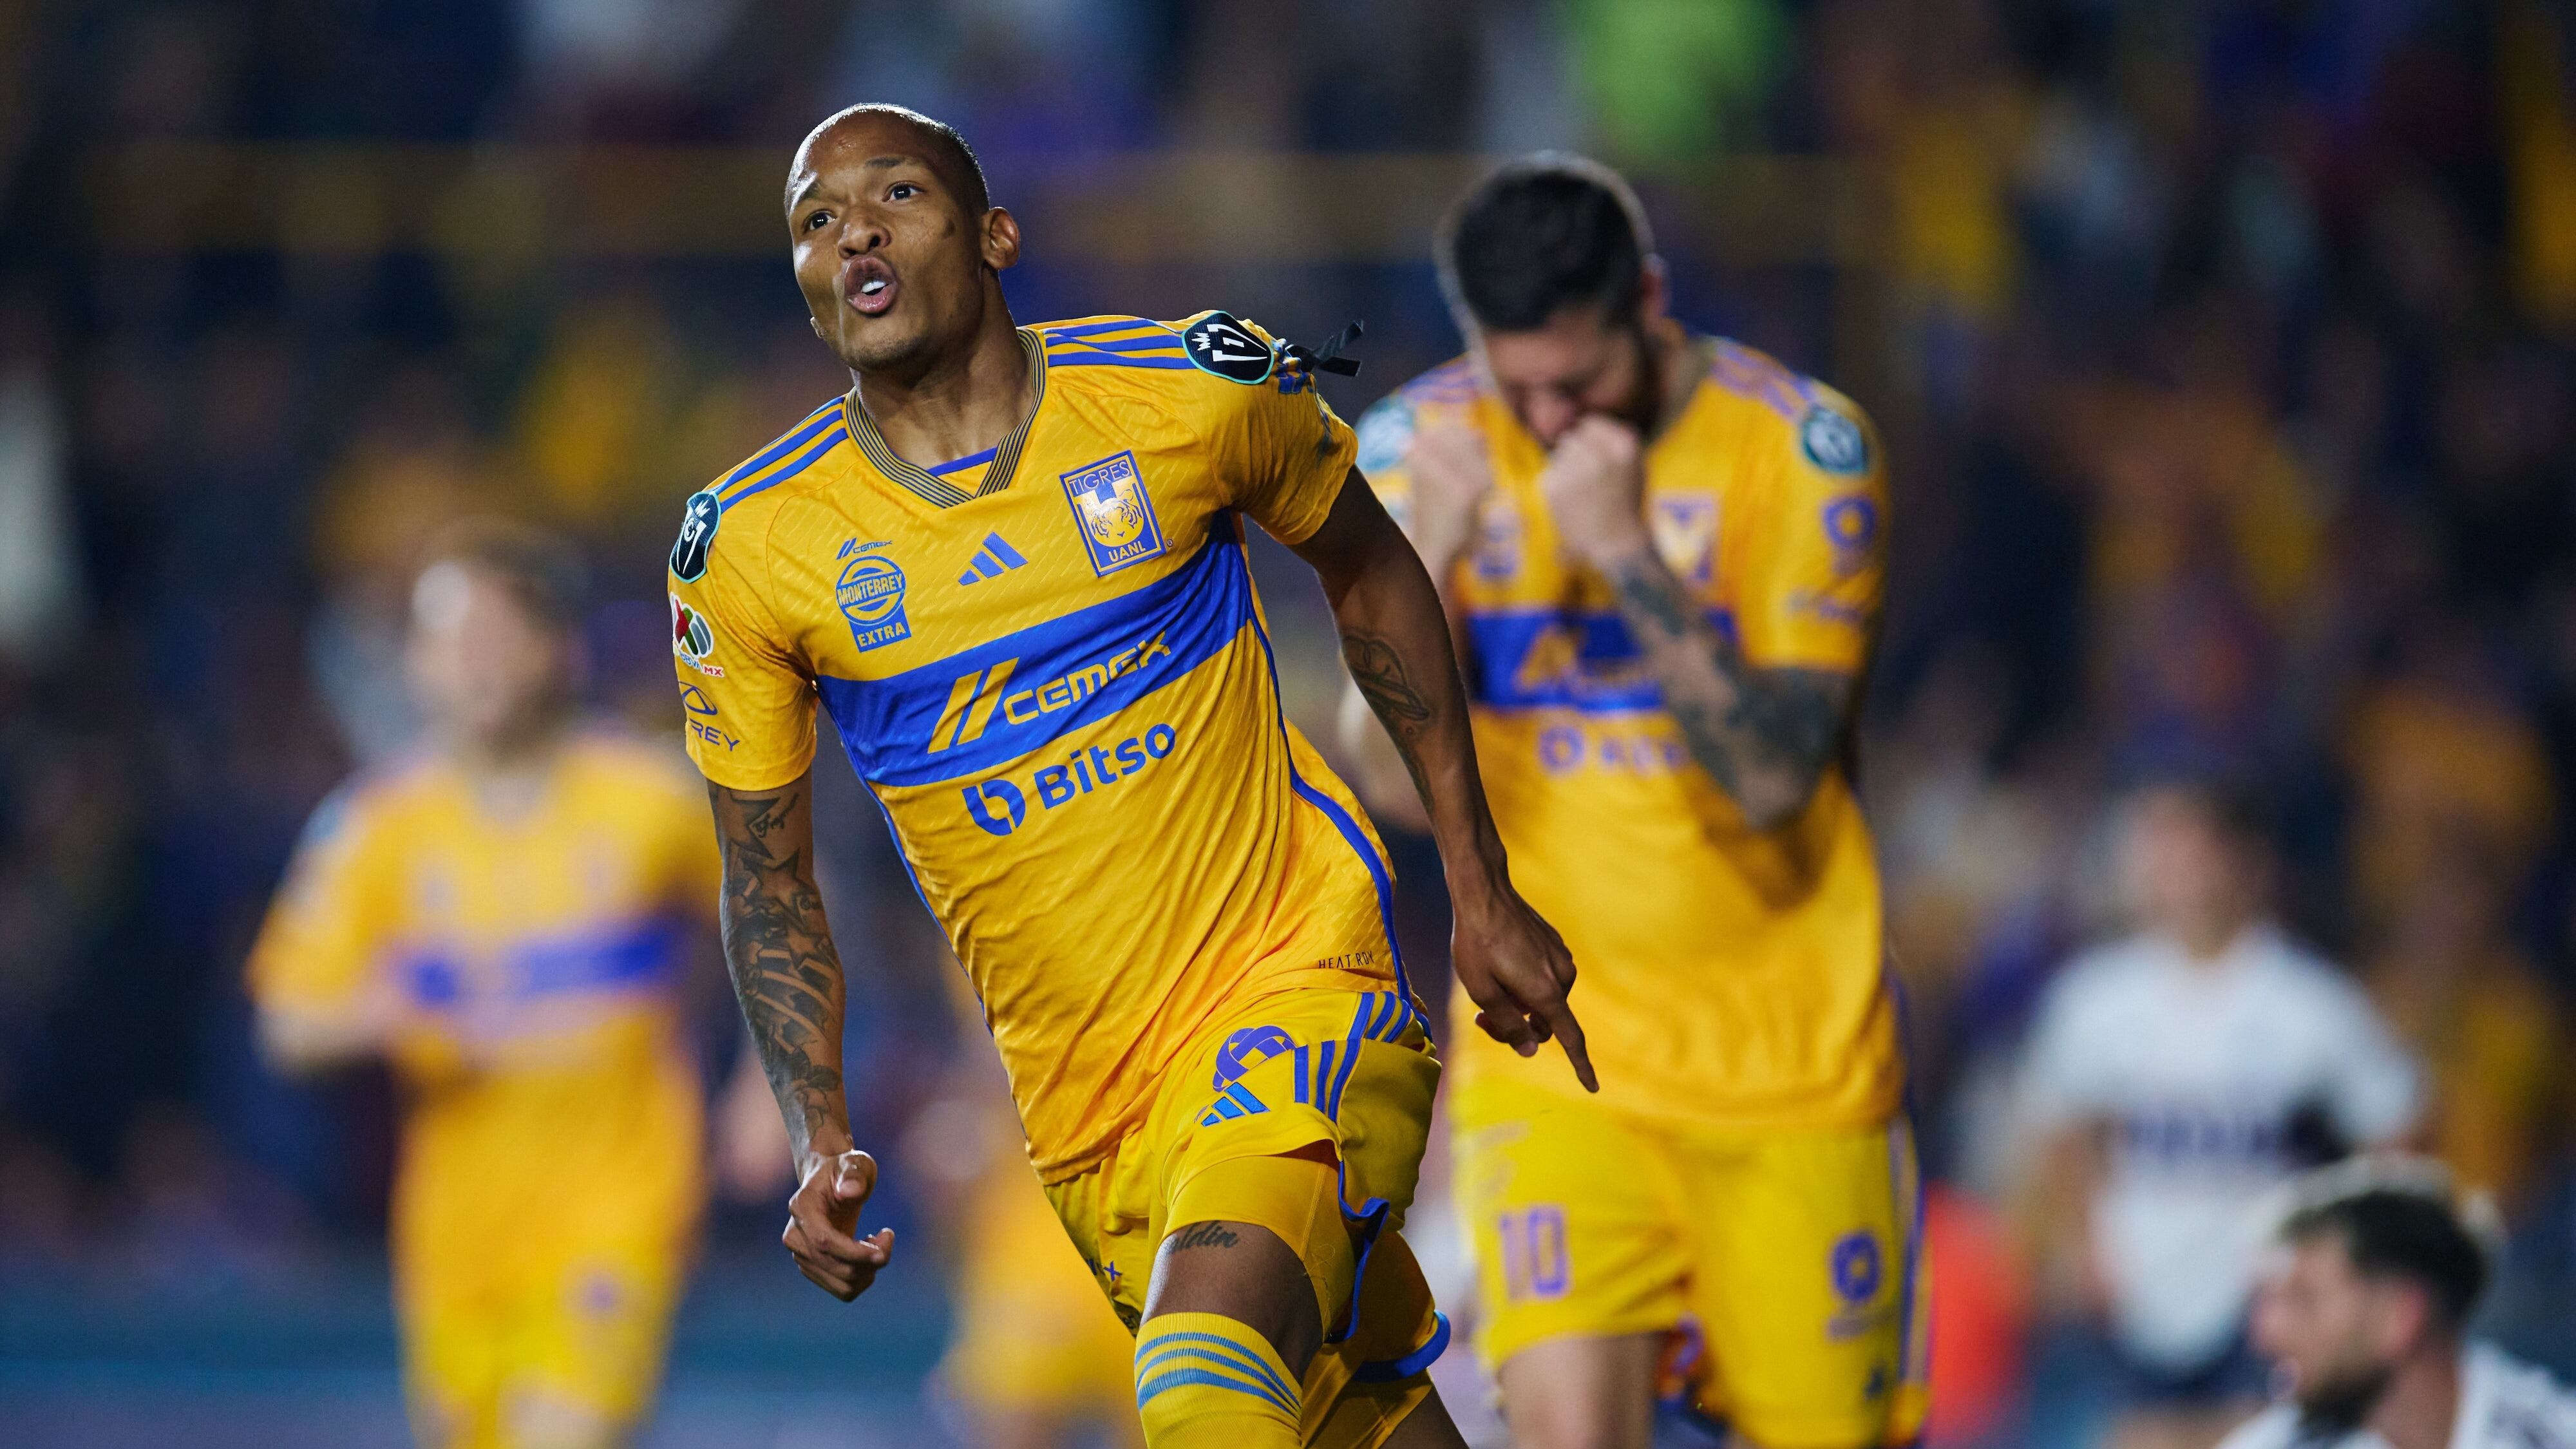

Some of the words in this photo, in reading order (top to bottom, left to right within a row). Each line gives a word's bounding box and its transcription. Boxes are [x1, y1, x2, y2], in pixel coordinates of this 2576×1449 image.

[1069, 461, 1130, 495] TIGRES
[853, 540, 893, 554] CEMEX
[1108, 540, 1146, 562] UANL
[837, 573, 903, 606] MONTERREY
[857, 622, 905, 647] EXTRA
[704, 666, 723, 676] MX
[1003, 630, 1171, 725] CEMEX
[1033, 723, 1177, 810] Bitso
[1318, 951, 1374, 969] HEAT.RDY
[1499, 1206, 1567, 1299] 10
